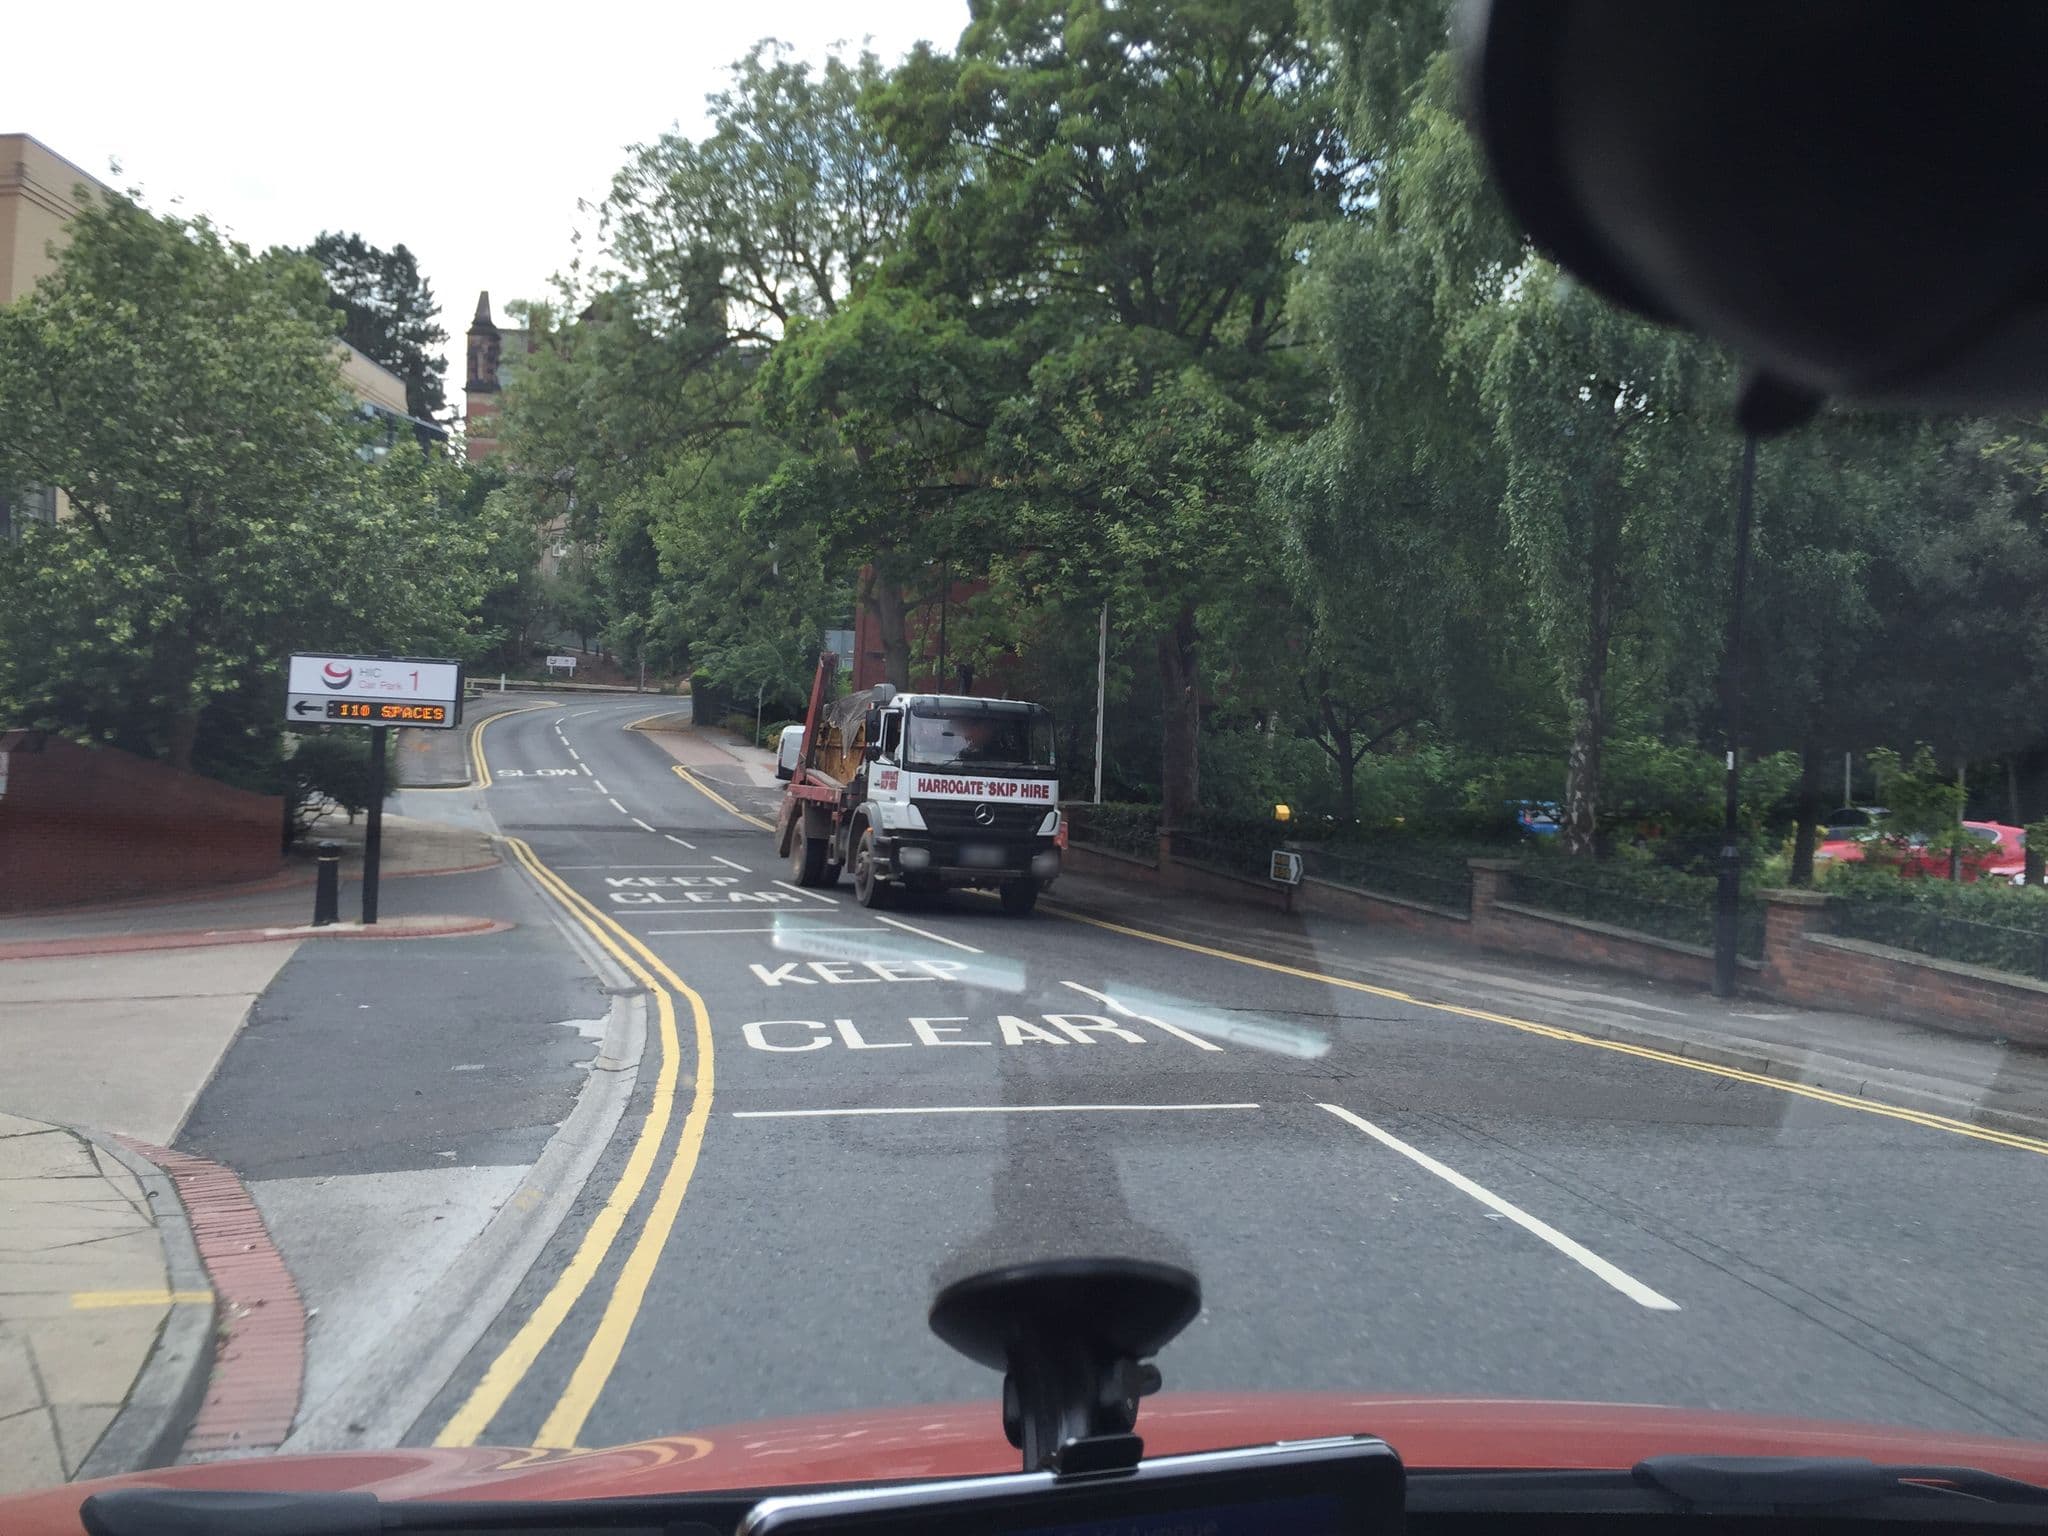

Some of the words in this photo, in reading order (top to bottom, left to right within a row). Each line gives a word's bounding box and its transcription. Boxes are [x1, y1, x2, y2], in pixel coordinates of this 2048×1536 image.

[359, 667, 382, 678] HIC
[359, 680, 376, 689] Car
[380, 681, 402, 691] Park
[409, 669, 418, 691] 1
[340, 703, 370, 717] 110
[381, 705, 445, 720] SPACES
[496, 768, 578, 777] SLOW
[918, 778, 983, 795] HARROGATE
[988, 781, 1017, 797] SKIP
[1020, 783, 1050, 799] HIRE
[604, 876, 739, 887] KEEP
[609, 892, 802, 904] CLEAR
[748, 960, 970, 986] KEEP
[742, 1013, 1147, 1052] CLEAR
